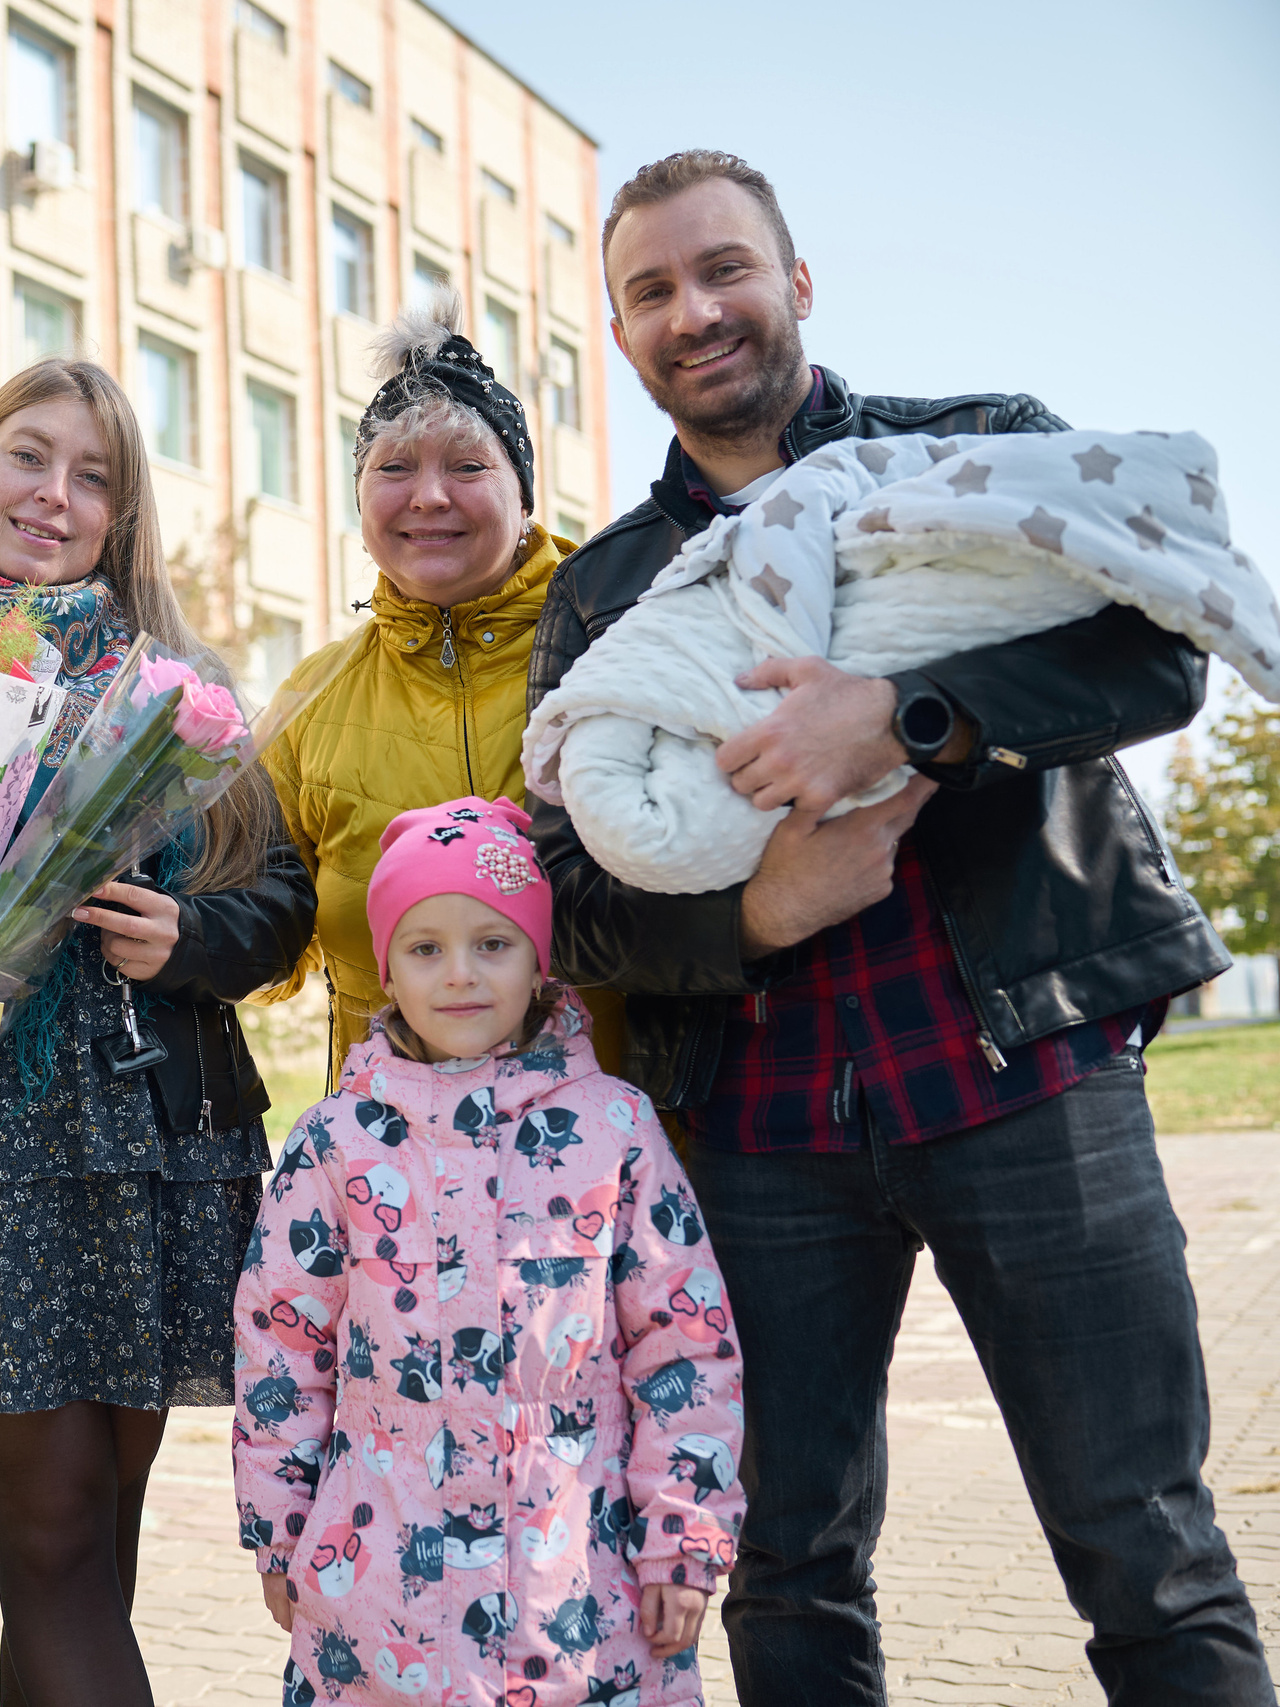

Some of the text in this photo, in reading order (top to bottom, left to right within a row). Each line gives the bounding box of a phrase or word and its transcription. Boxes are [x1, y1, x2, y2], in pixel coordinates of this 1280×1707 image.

[449, 810, 485, 819] Love
[429, 825, 465, 841] Love
[256, 1392, 289, 1413] Hello
